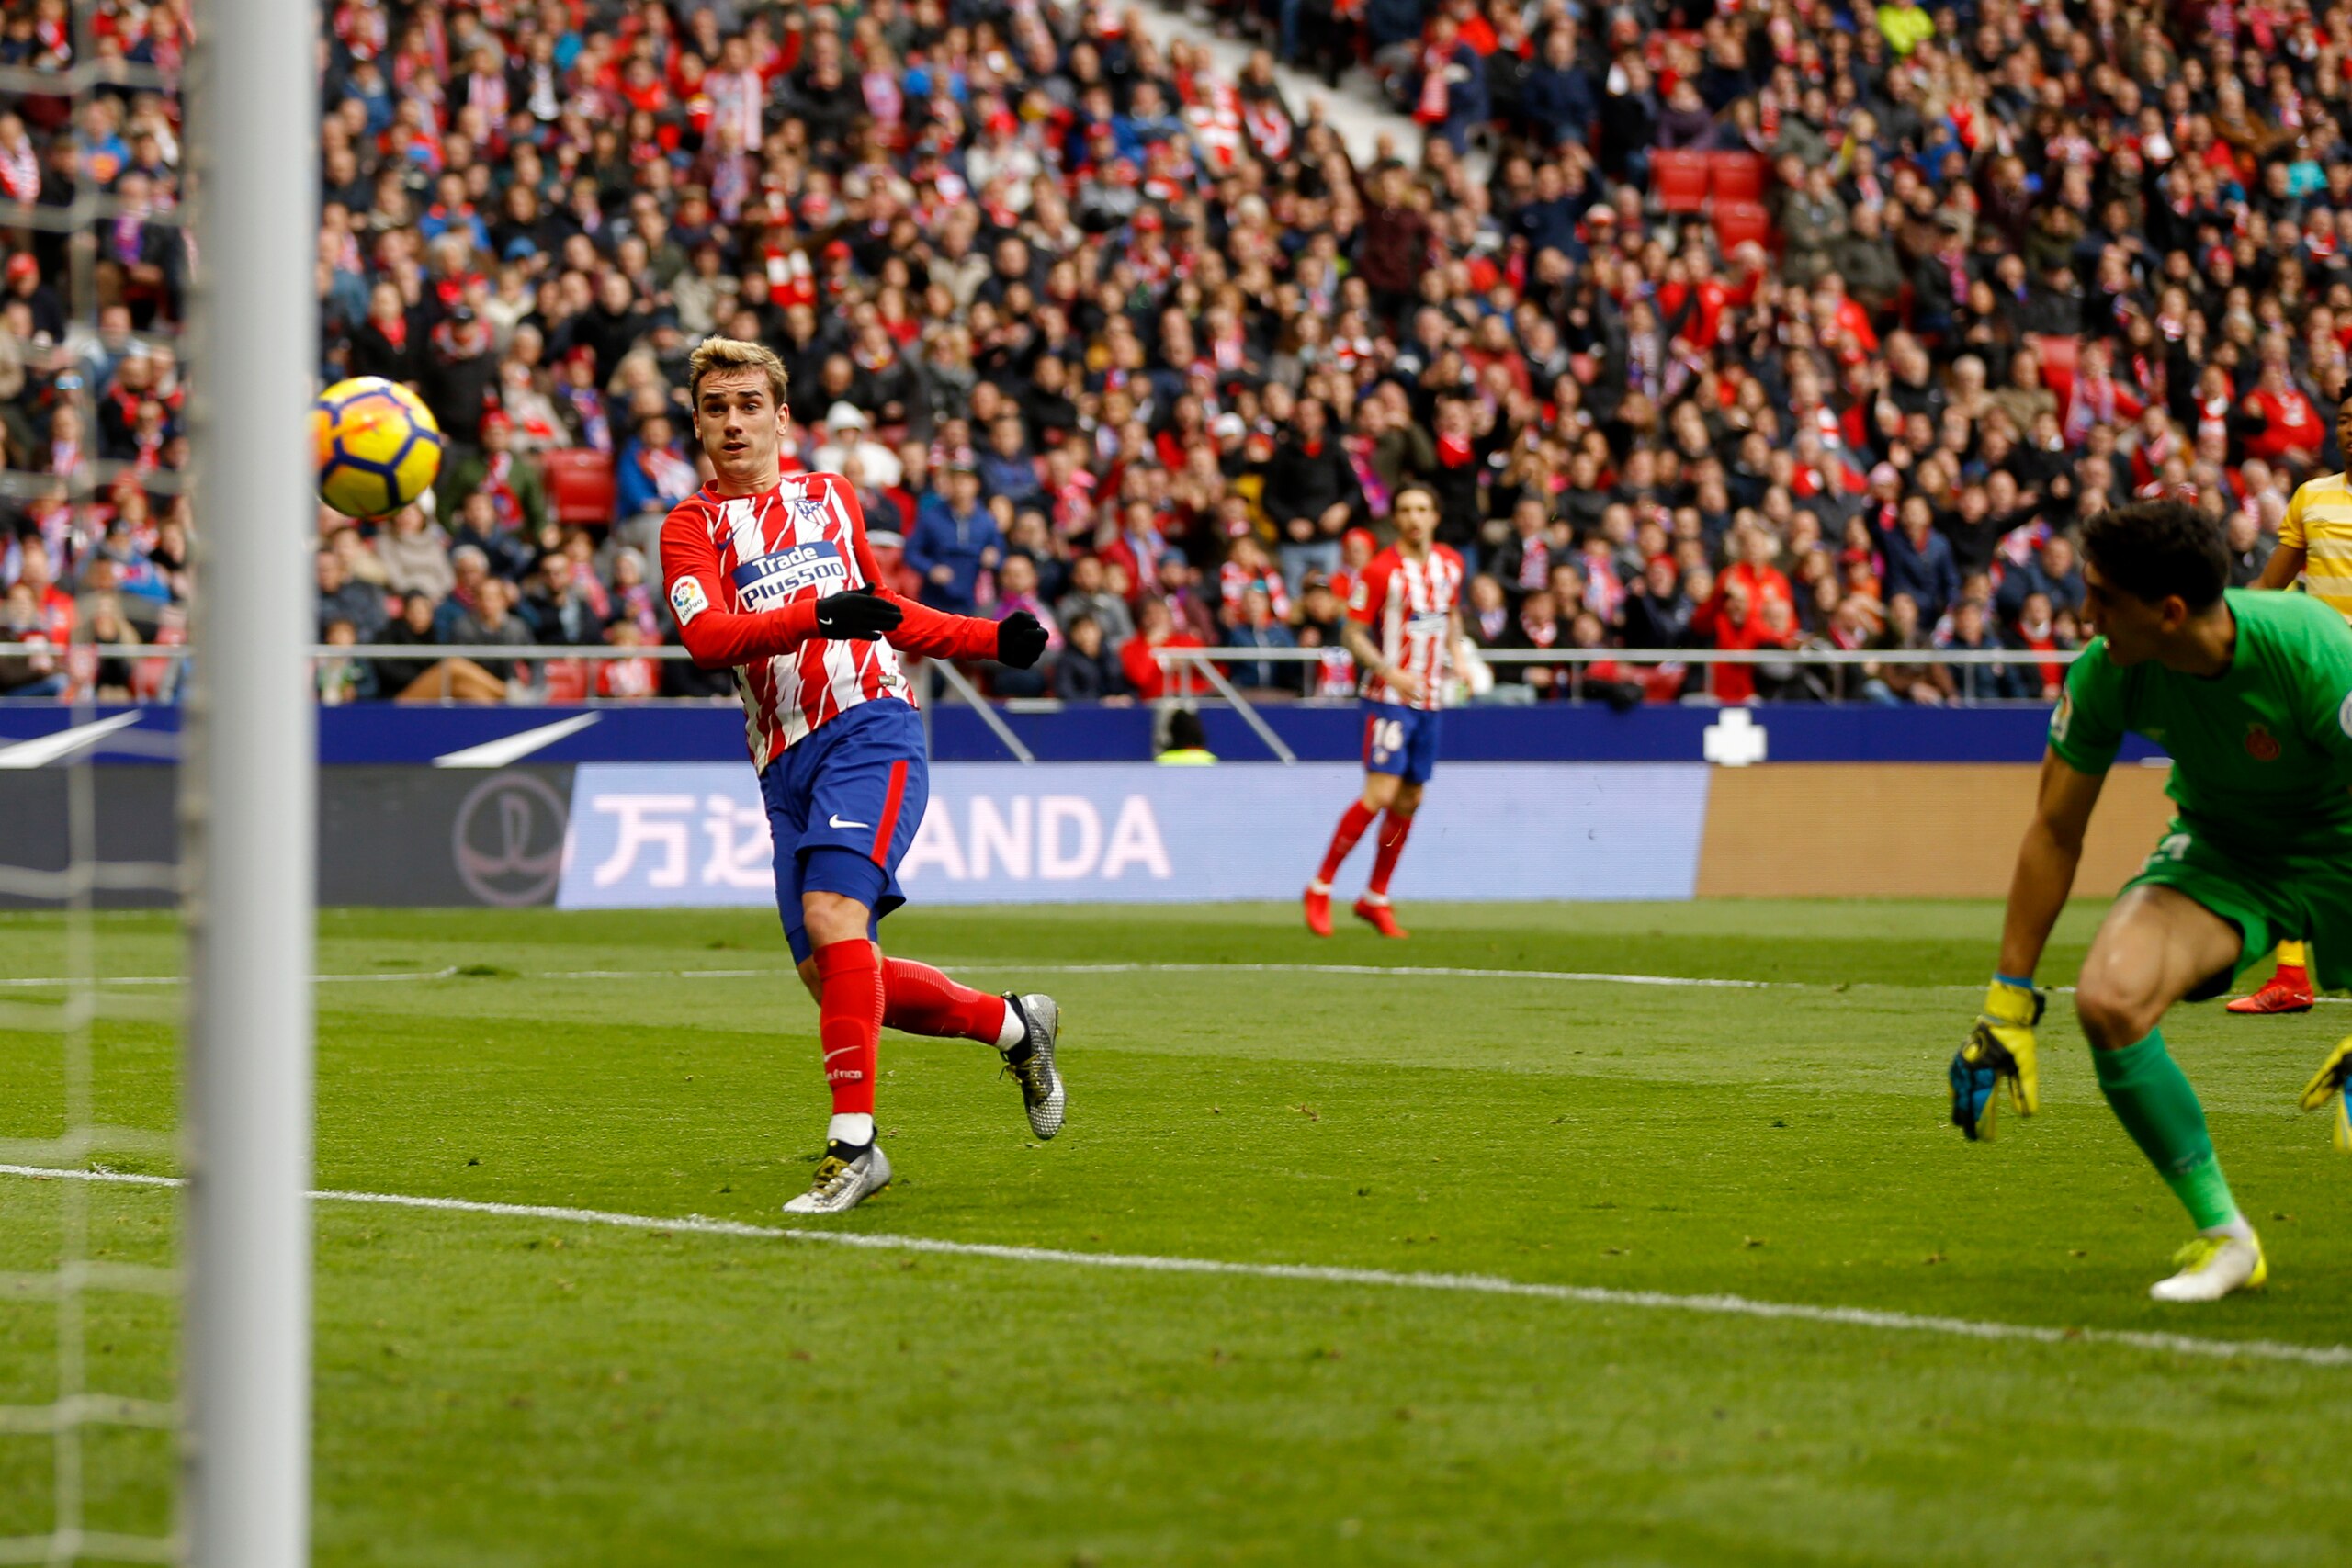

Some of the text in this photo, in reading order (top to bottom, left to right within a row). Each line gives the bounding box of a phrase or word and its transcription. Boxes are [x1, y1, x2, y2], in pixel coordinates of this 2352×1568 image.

[752, 546, 819, 576] Trade
[743, 562, 844, 609] Plus500
[895, 795, 1172, 880] ANDA
